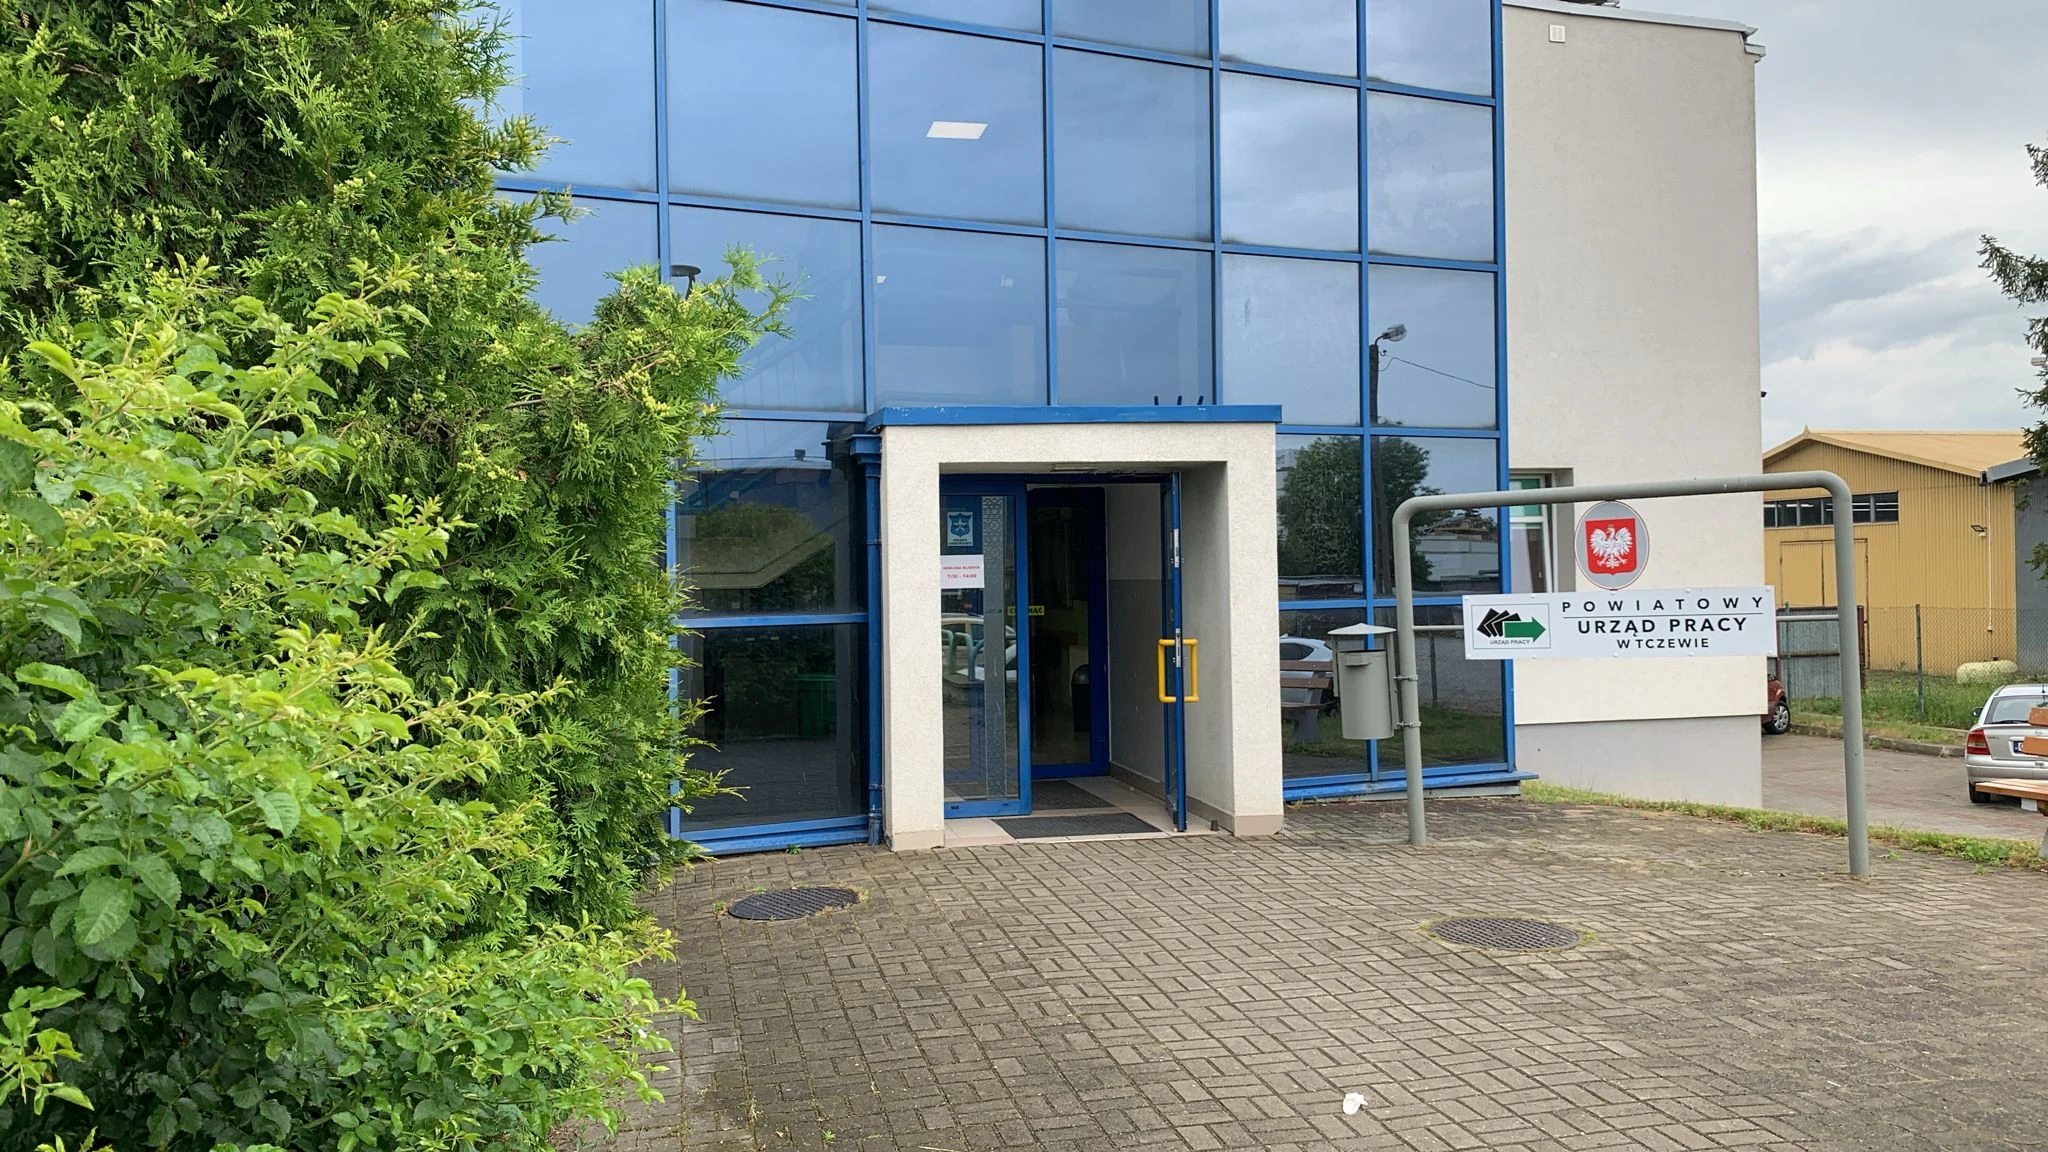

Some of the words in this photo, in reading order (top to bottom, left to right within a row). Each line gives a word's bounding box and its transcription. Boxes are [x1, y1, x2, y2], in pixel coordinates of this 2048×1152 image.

[1562, 597, 1763, 613] POWIATOWY
[1578, 619, 1655, 637] URZĄD
[1669, 617, 1747, 632] PRACY
